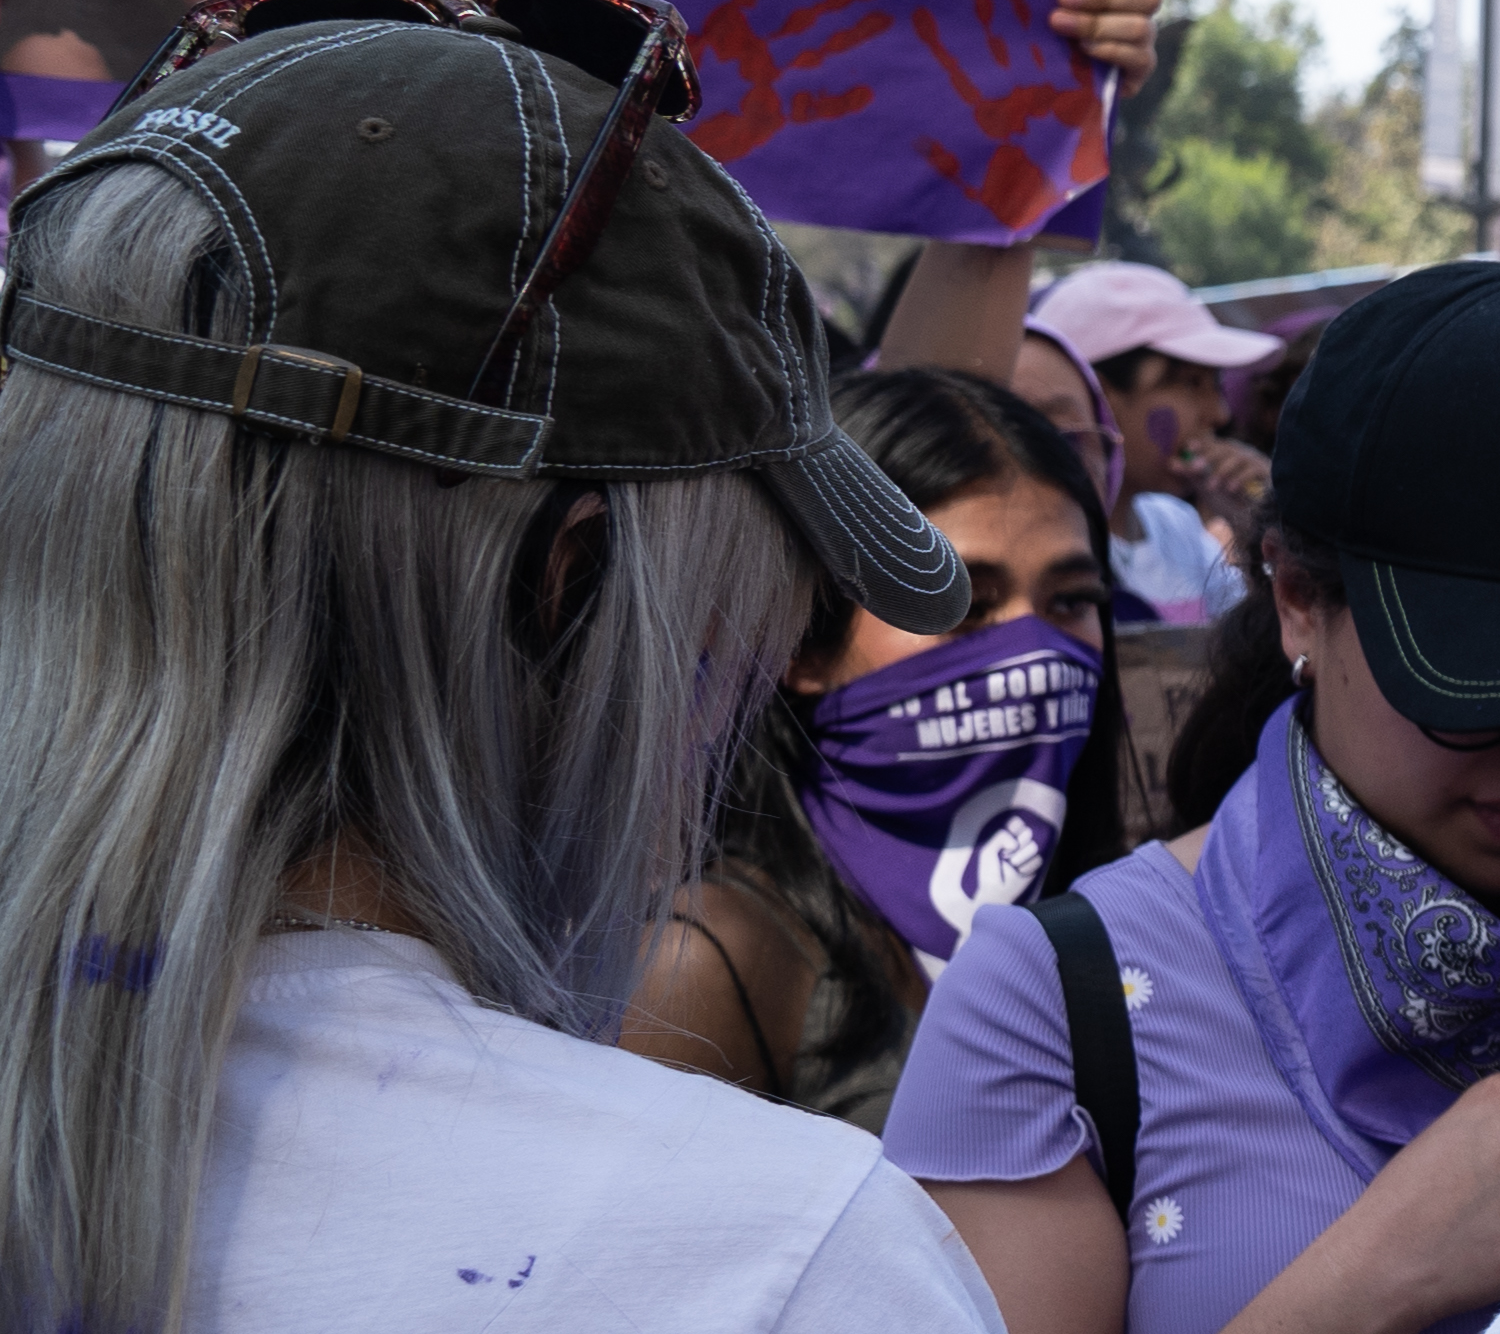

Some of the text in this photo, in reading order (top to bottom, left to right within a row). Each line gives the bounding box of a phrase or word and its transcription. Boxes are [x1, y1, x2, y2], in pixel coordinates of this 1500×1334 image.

[134, 107, 241, 149] FOSSIL
[935, 681, 972, 712] AL
[915, 701, 1038, 749] MUJERES
